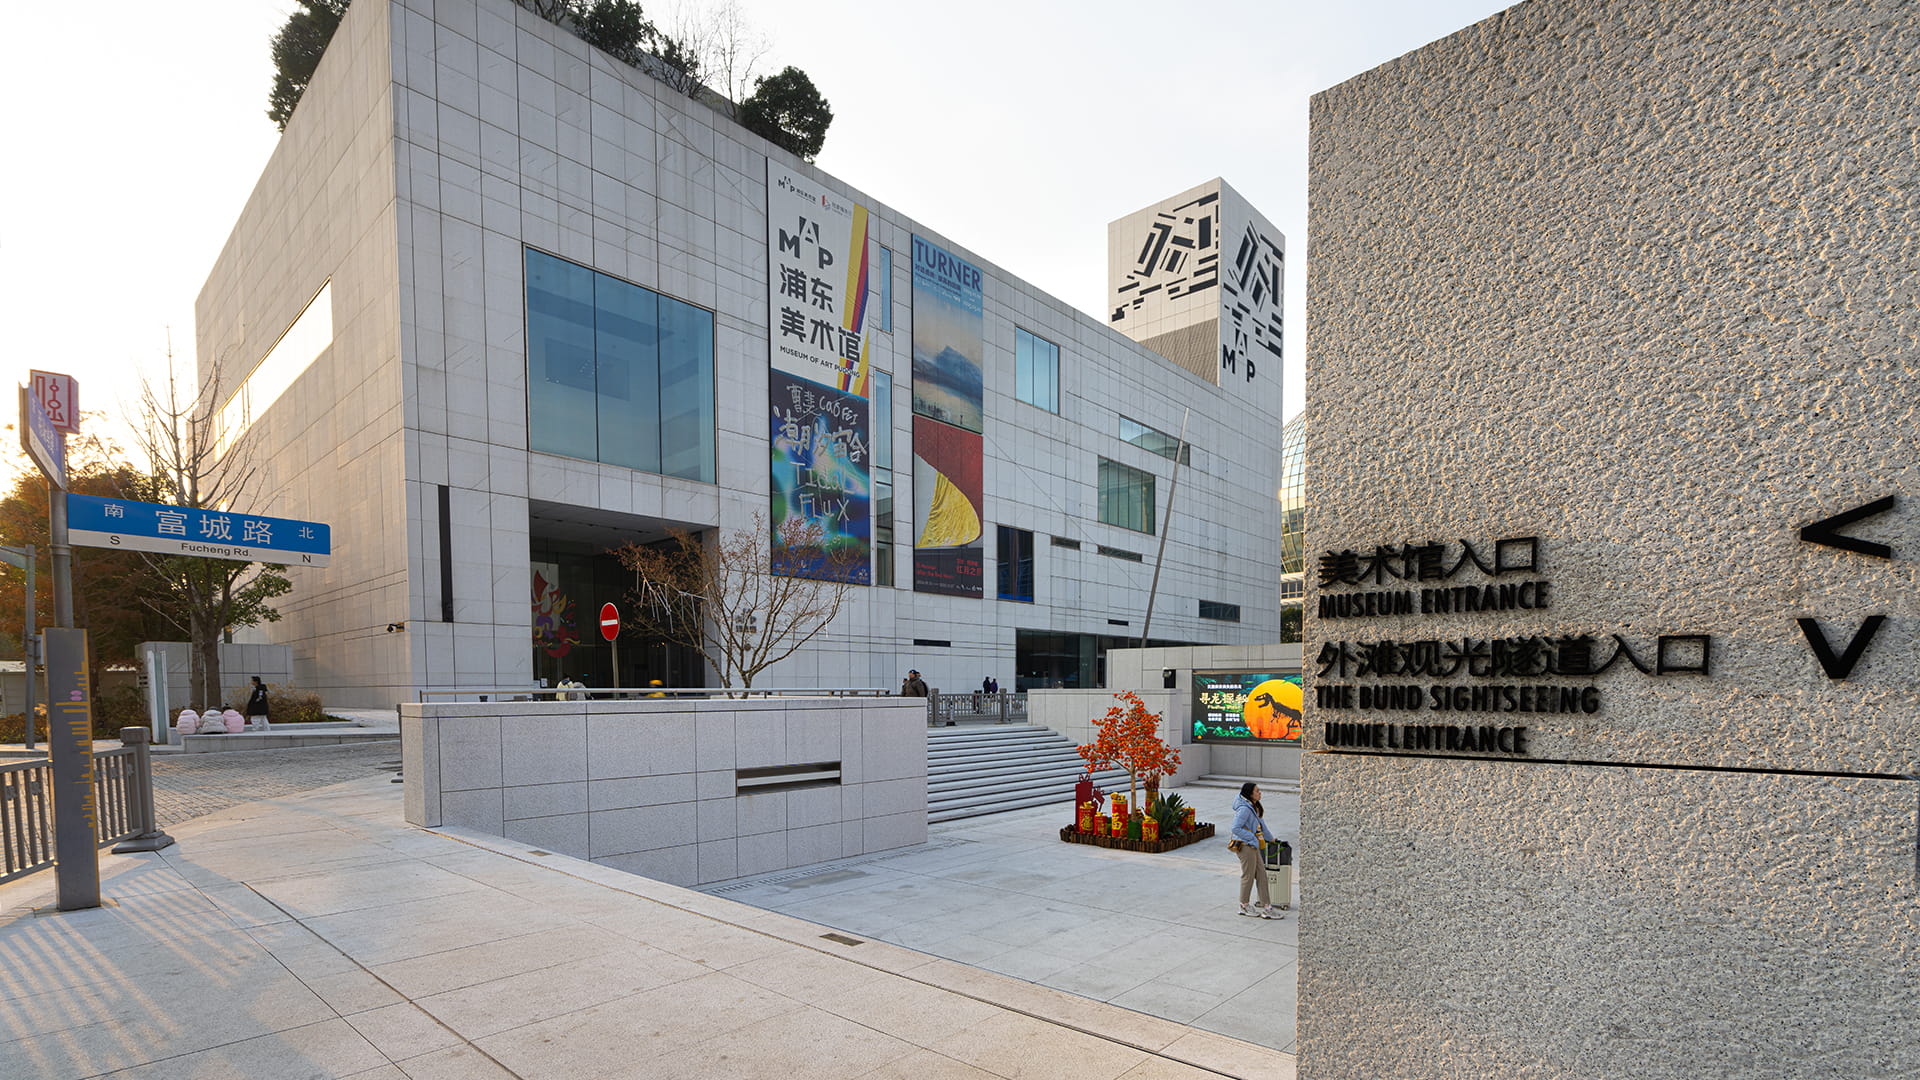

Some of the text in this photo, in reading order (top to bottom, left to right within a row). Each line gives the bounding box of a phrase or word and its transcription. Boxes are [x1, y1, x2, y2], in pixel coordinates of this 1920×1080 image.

[779, 216, 833, 269] MAP
[915, 239, 981, 292] TURNER
[780, 263, 833, 314] 浦东
[780, 306, 861, 363] 美术馆
[1222, 327, 1256, 383] MAP
[780, 345, 860, 378] MUSEUM OF ART PUDONG
[104, 503, 314, 545] 南 富城路 北
[110, 535, 312, 563] S Fucheng Rd. N
[1318, 536, 1538, 588] 美术馆入口
[1318, 581, 1549, 619] MUSEUM ENTRANCE
[1315, 633, 1711, 678] 外滩观光隧道入口
[1314, 685, 1600, 714] THE BUND SIGHTSEEING
[1402, 726, 1527, 754] ENTRANCE
